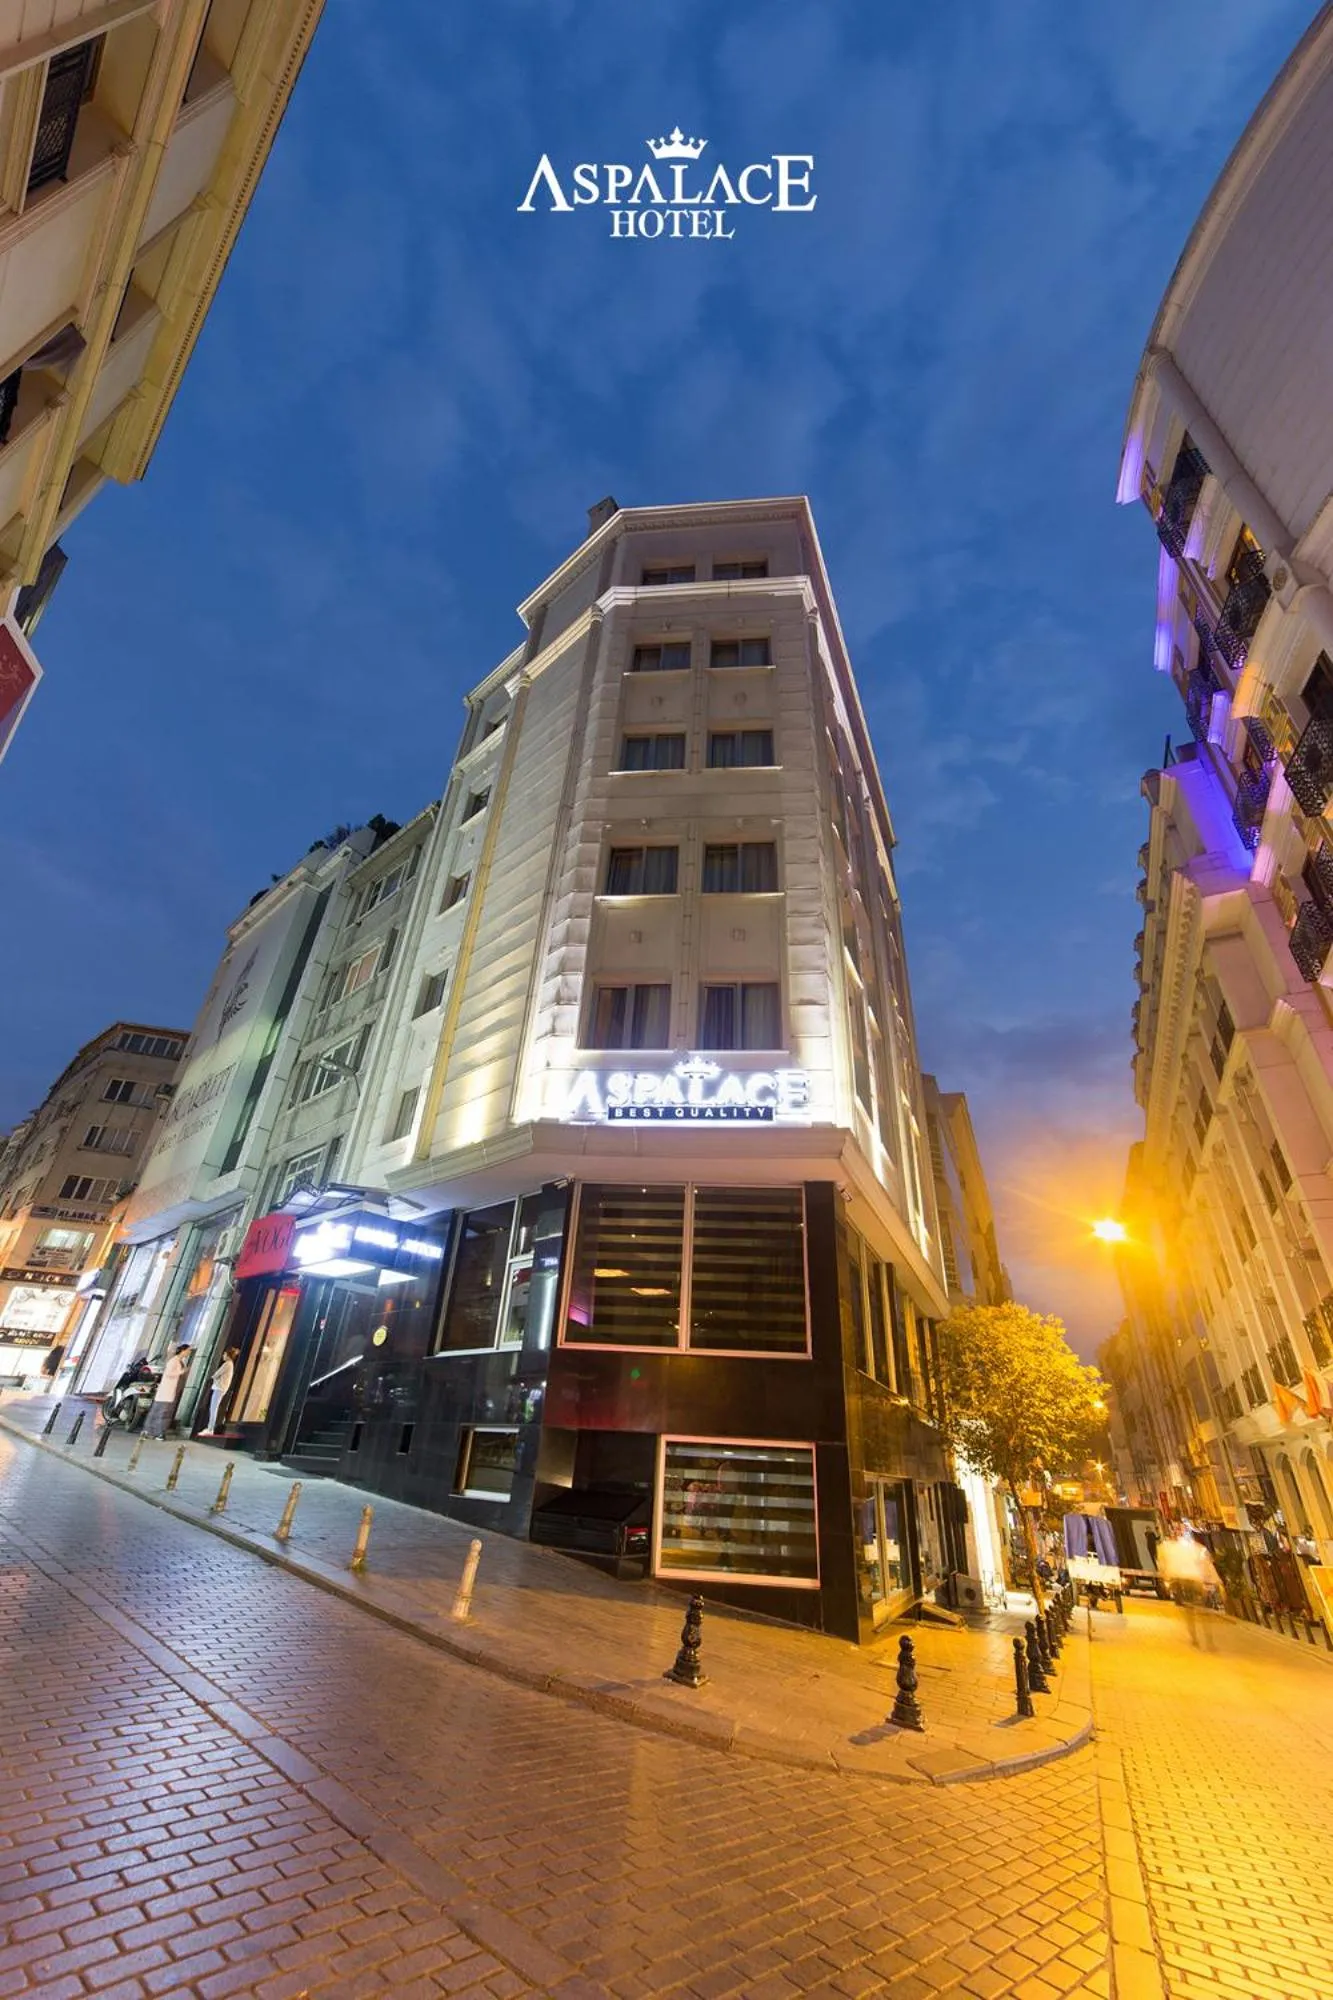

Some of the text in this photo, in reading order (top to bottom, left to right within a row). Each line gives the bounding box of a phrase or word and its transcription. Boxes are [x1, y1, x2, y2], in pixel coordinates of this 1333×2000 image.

[563, 1069, 811, 1122] ASPALACE
[614, 1107, 767, 1118] BEST QUALITY
